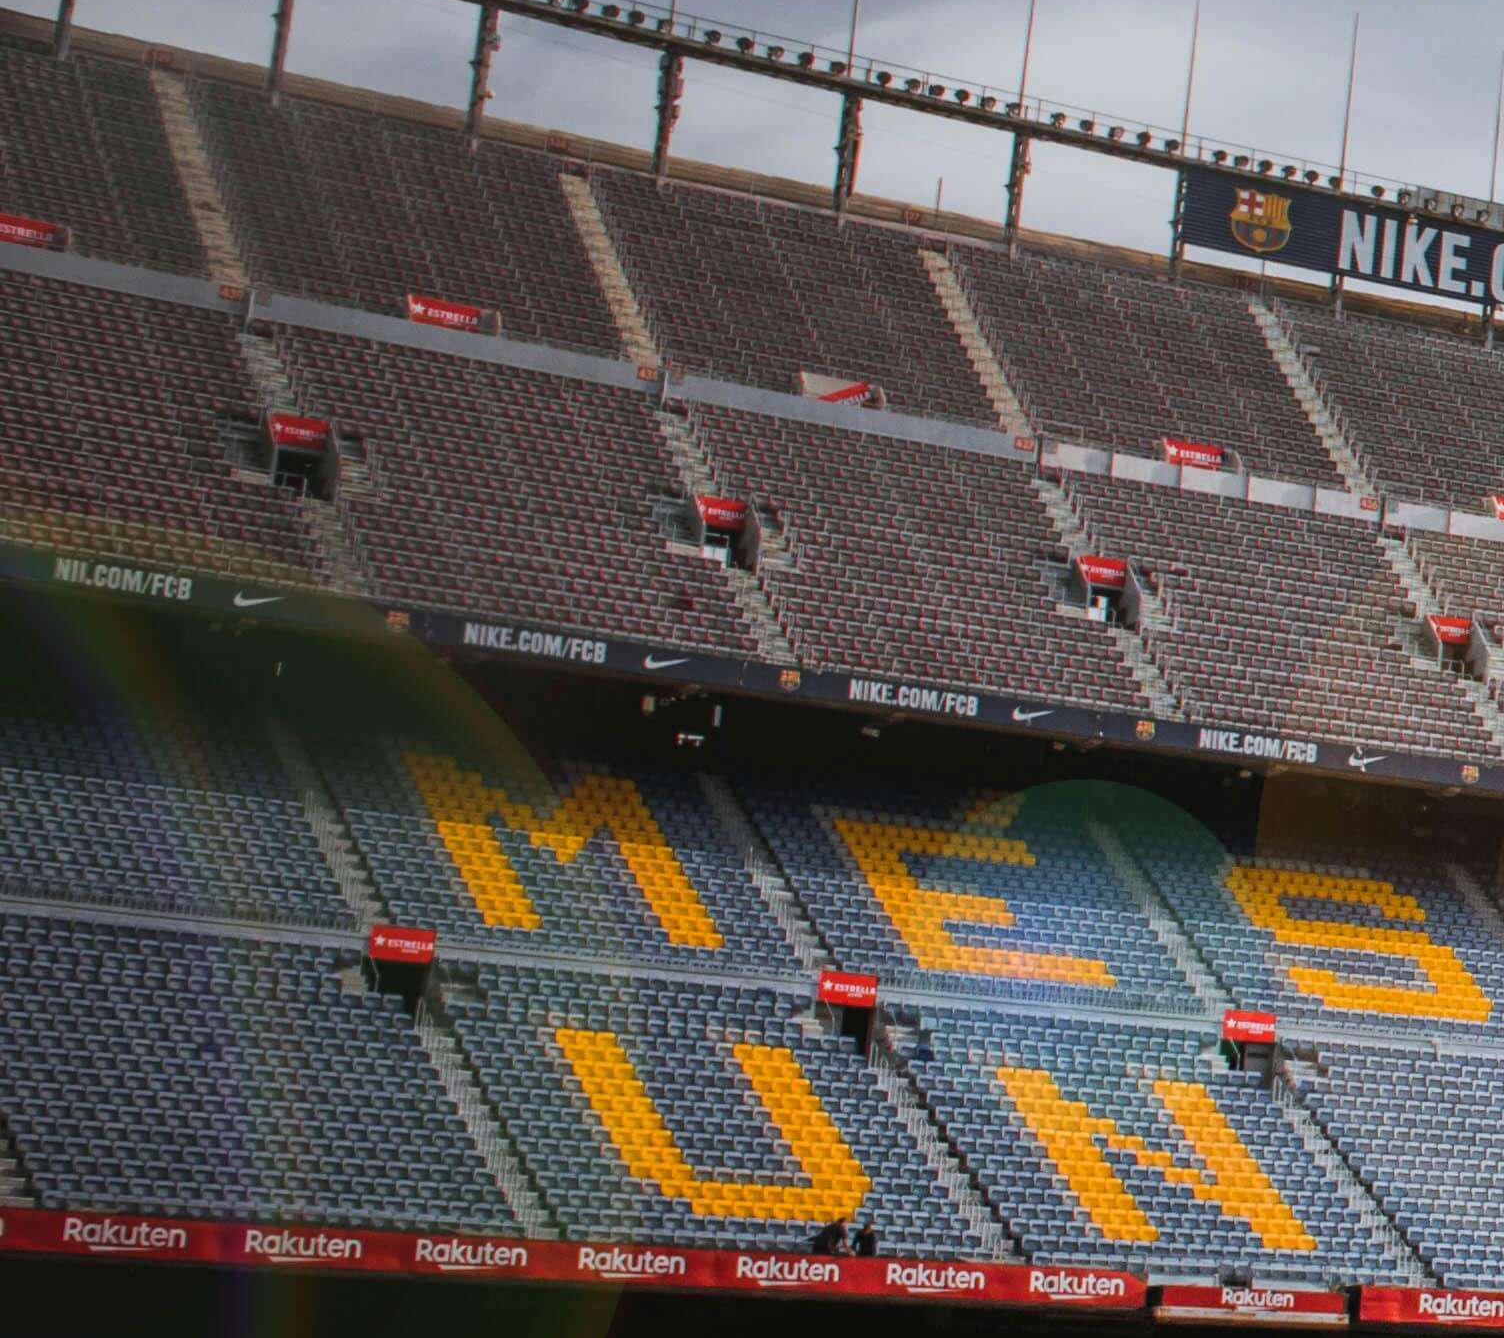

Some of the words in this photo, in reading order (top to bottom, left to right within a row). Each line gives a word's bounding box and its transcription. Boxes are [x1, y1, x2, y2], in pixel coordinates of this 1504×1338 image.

[1180, 449, 1221, 463] ESTRELLA
[464, 622, 606, 663] NIKE.COM/FCB
[849, 679, 978, 716] NIKE.COM/FCB
[1199, 728, 1317, 763] NIKE.COM/FCB
[388, 939, 433, 951] ESTRELLA
[835, 983, 875, 994] ESTRELLA
[1238, 1021, 1274, 1031] ESTRELLA
[555, 1028, 1317, 1250] UN
[63, 1217, 186, 1249] Rakuten
[245, 1230, 362, 1258] Rakuten
[415, 1238, 528, 1266] Rakuten
[578, 1246, 686, 1274] Rakuten
[737, 1256, 839, 1282] Rakuten
[886, 1263, 985, 1289] Rakuten
[1030, 1271, 1124, 1296] Rakuten
[1222, 1288, 1294, 1308] Rakuten
[1419, 1293, 1504, 1318] Rakuten
